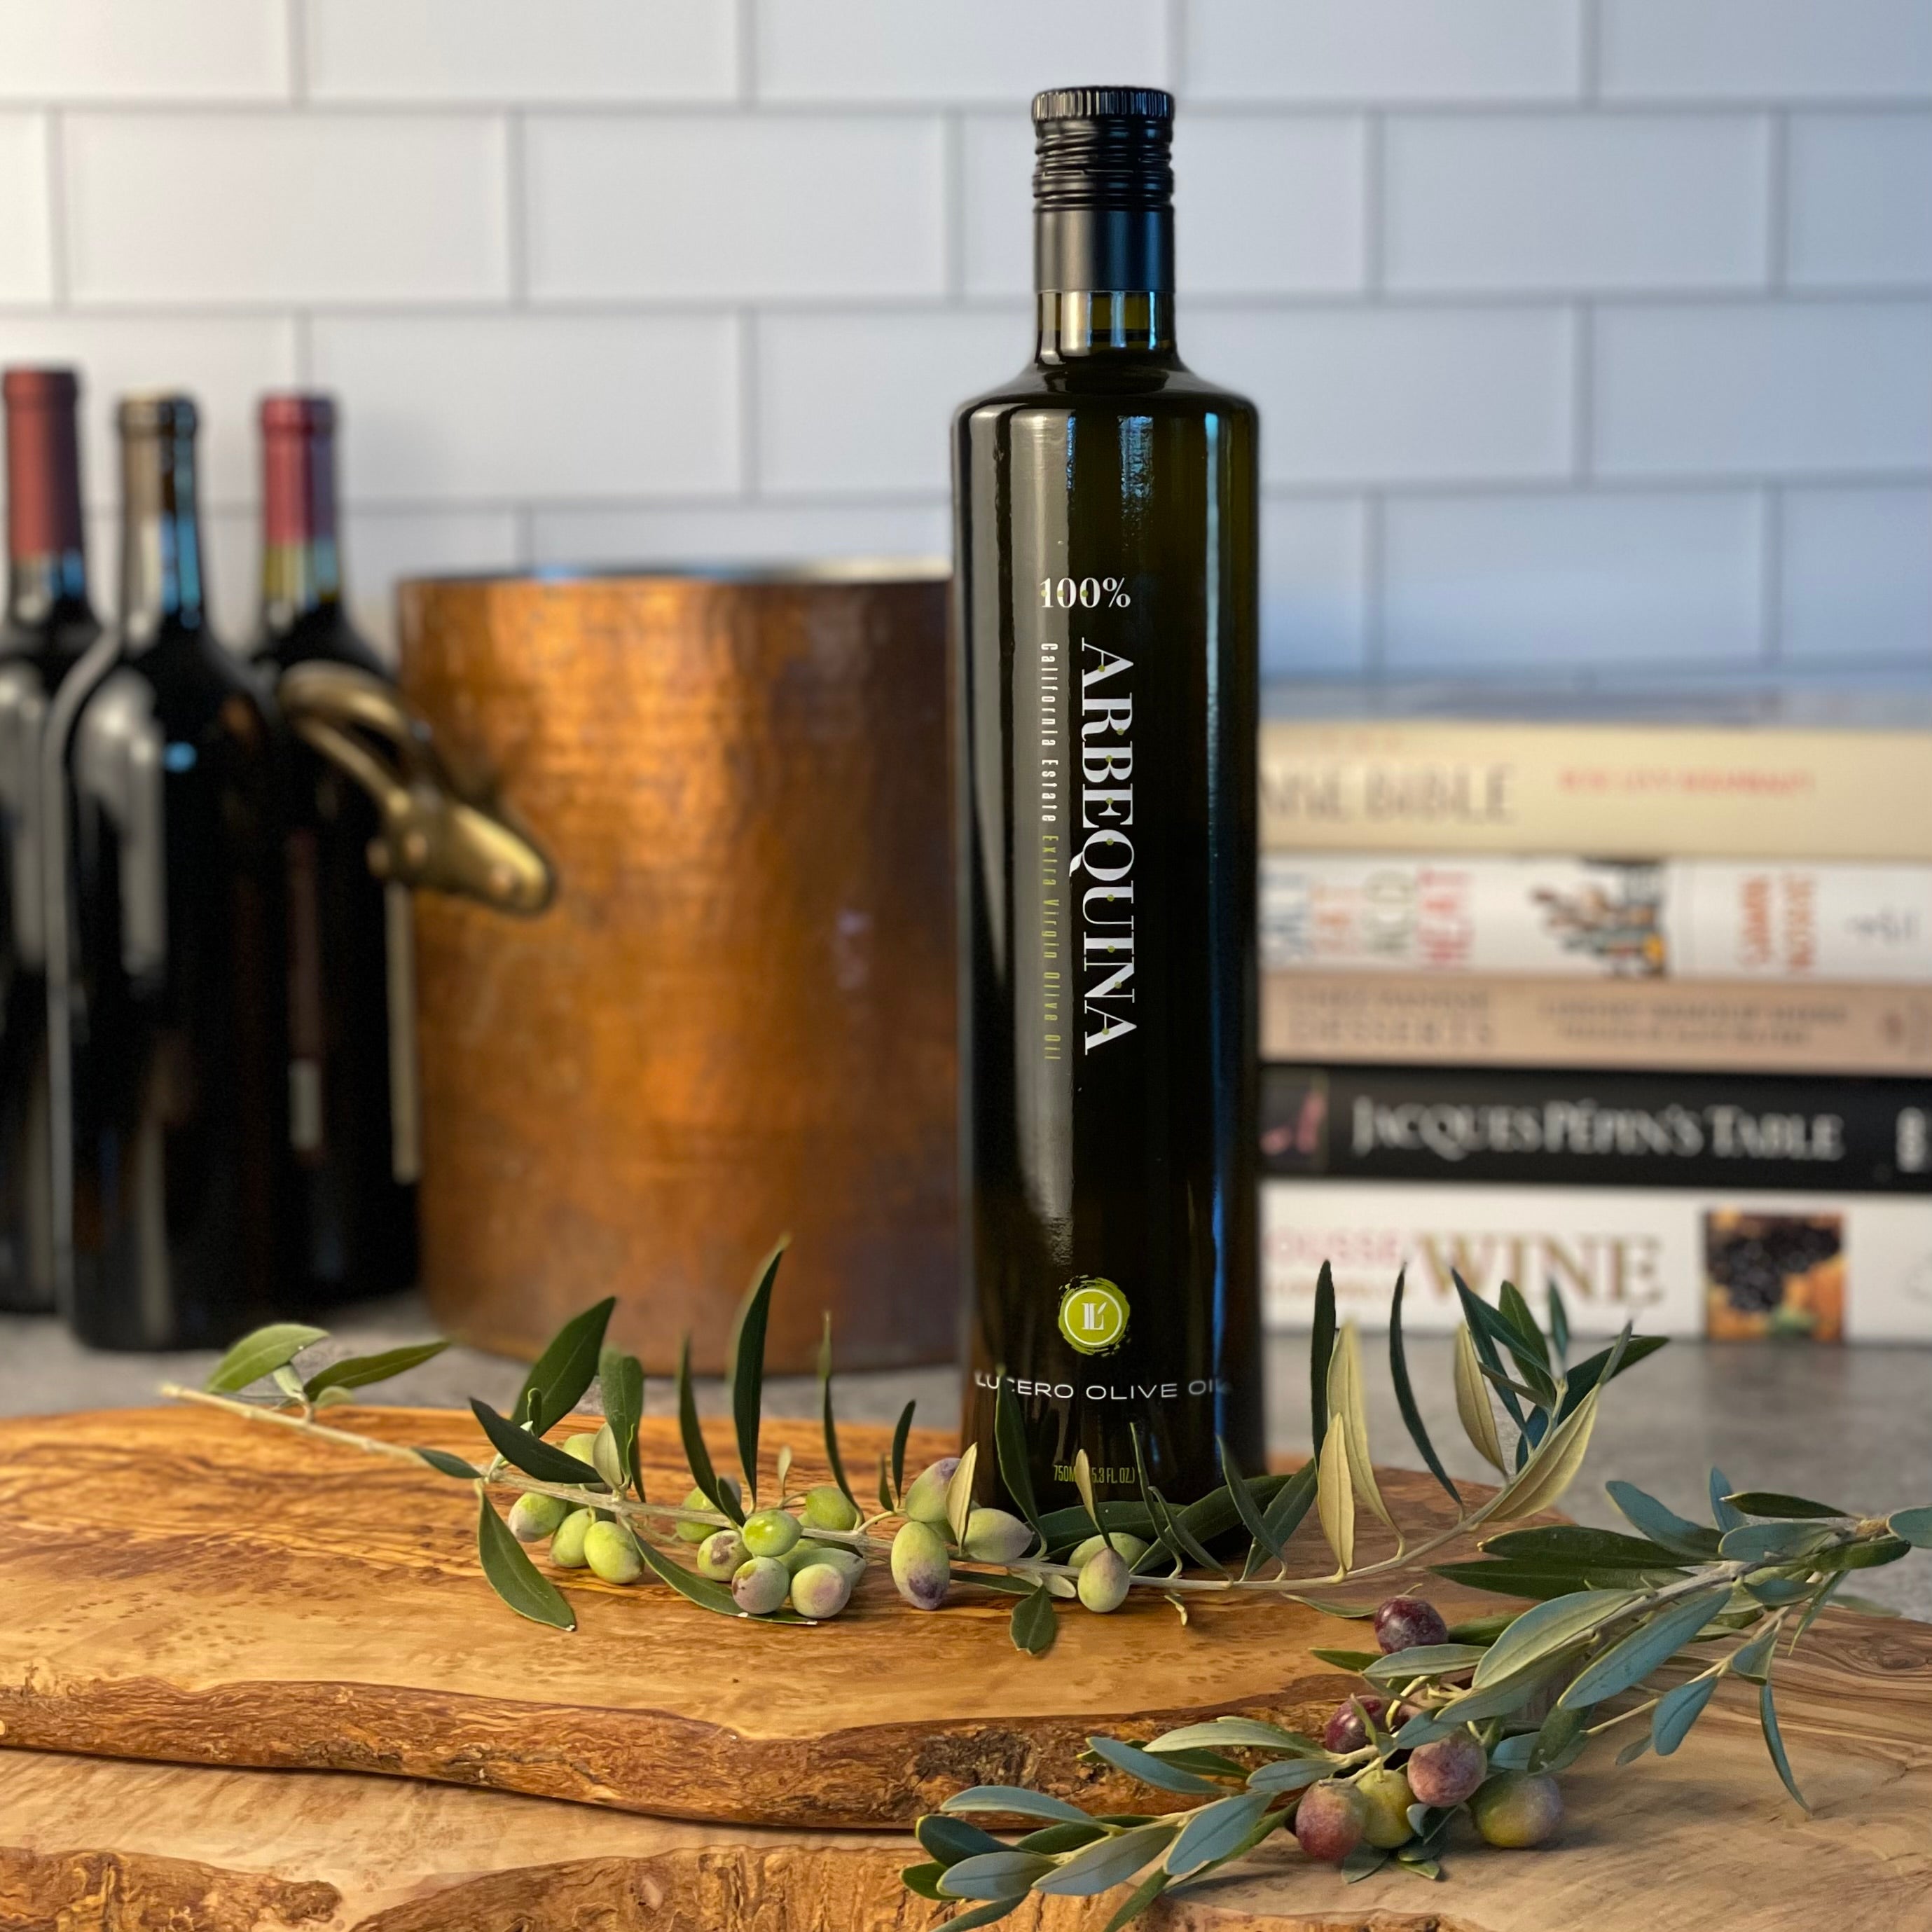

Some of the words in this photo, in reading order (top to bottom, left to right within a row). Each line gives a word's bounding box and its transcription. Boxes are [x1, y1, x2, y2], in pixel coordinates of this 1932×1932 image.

[1040, 577, 1131, 608] 100%
[1040, 642, 1058, 746] California
[1041, 759, 1058, 822] Estate
[1042, 835, 1058, 885] Extra
[1069, 636, 1137, 1056] ARBEQUINA
[1042, 899, 1060, 958] Virgin
[1043, 972, 1061, 1021] Olive
[1044, 1034, 1061, 1059] Oil
[1412, 1229, 1666, 1304] WINE
[974, 1371, 1074, 1399] LUERO
[1086, 1384, 1178, 1400] OLIVE
